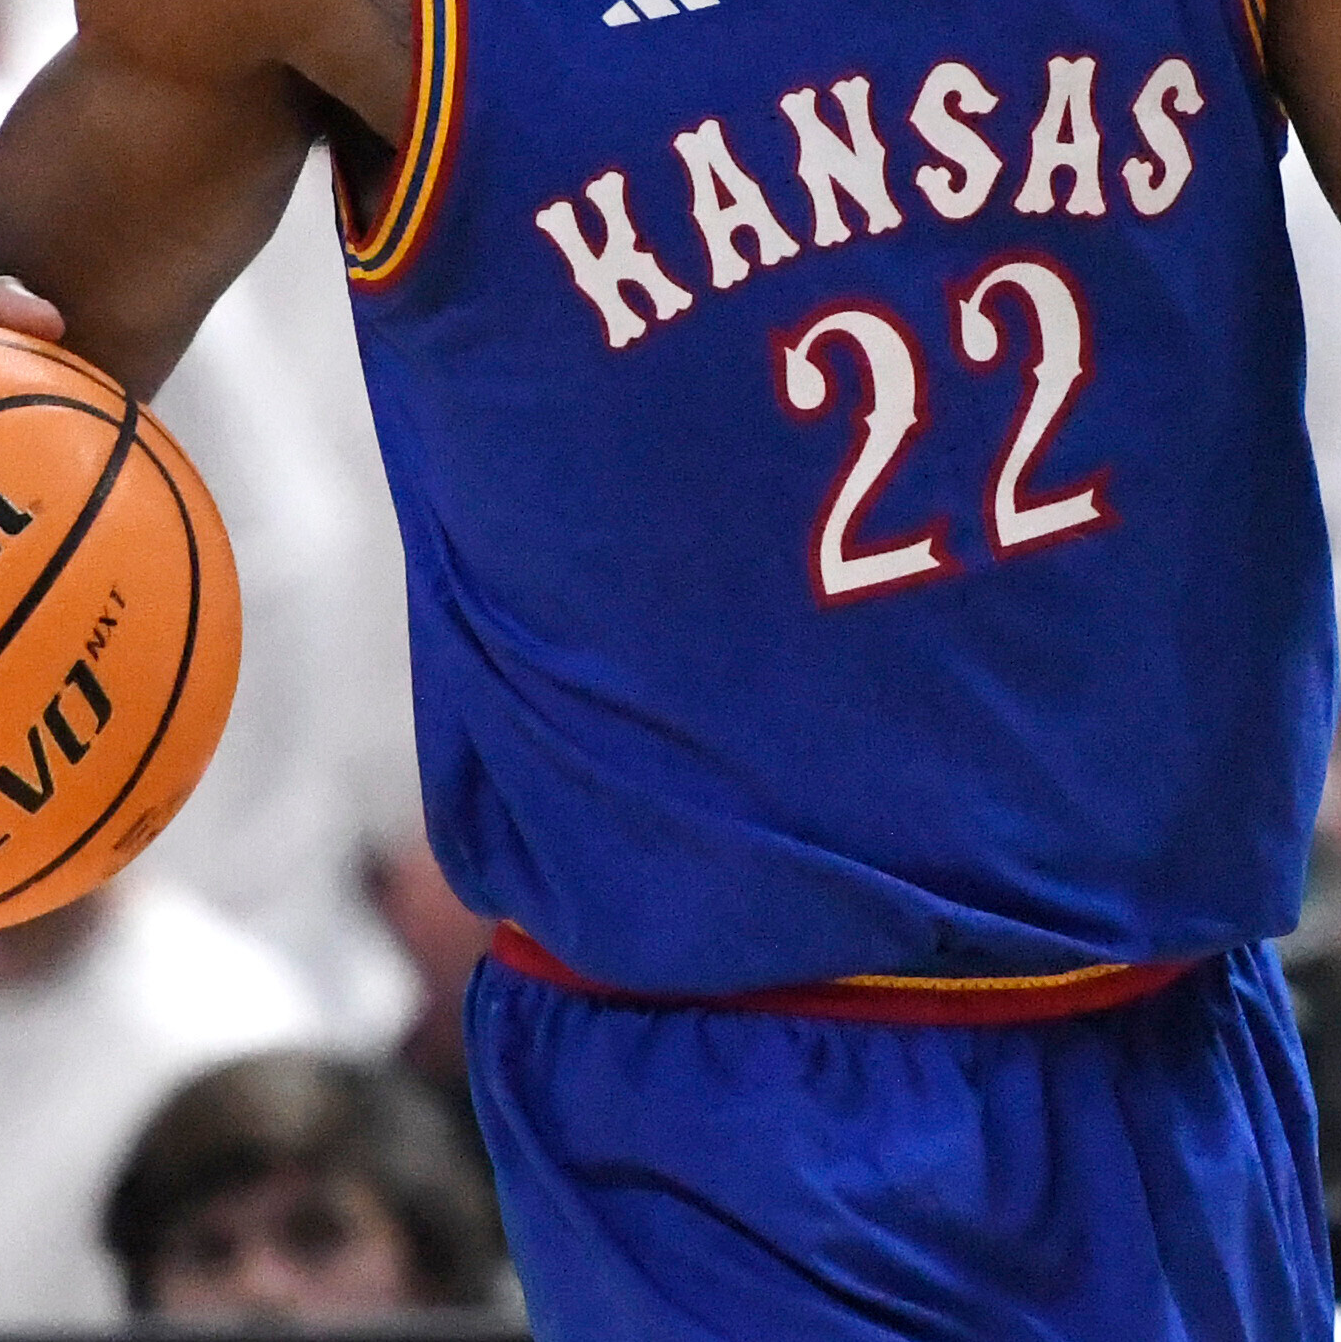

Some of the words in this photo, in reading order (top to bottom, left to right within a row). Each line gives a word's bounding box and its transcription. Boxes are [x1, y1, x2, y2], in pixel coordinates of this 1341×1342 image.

[534, 54, 1206, 350] KANSAS
[780, 257, 1106, 600] 22
[85, 584, 126, 662] NXT
